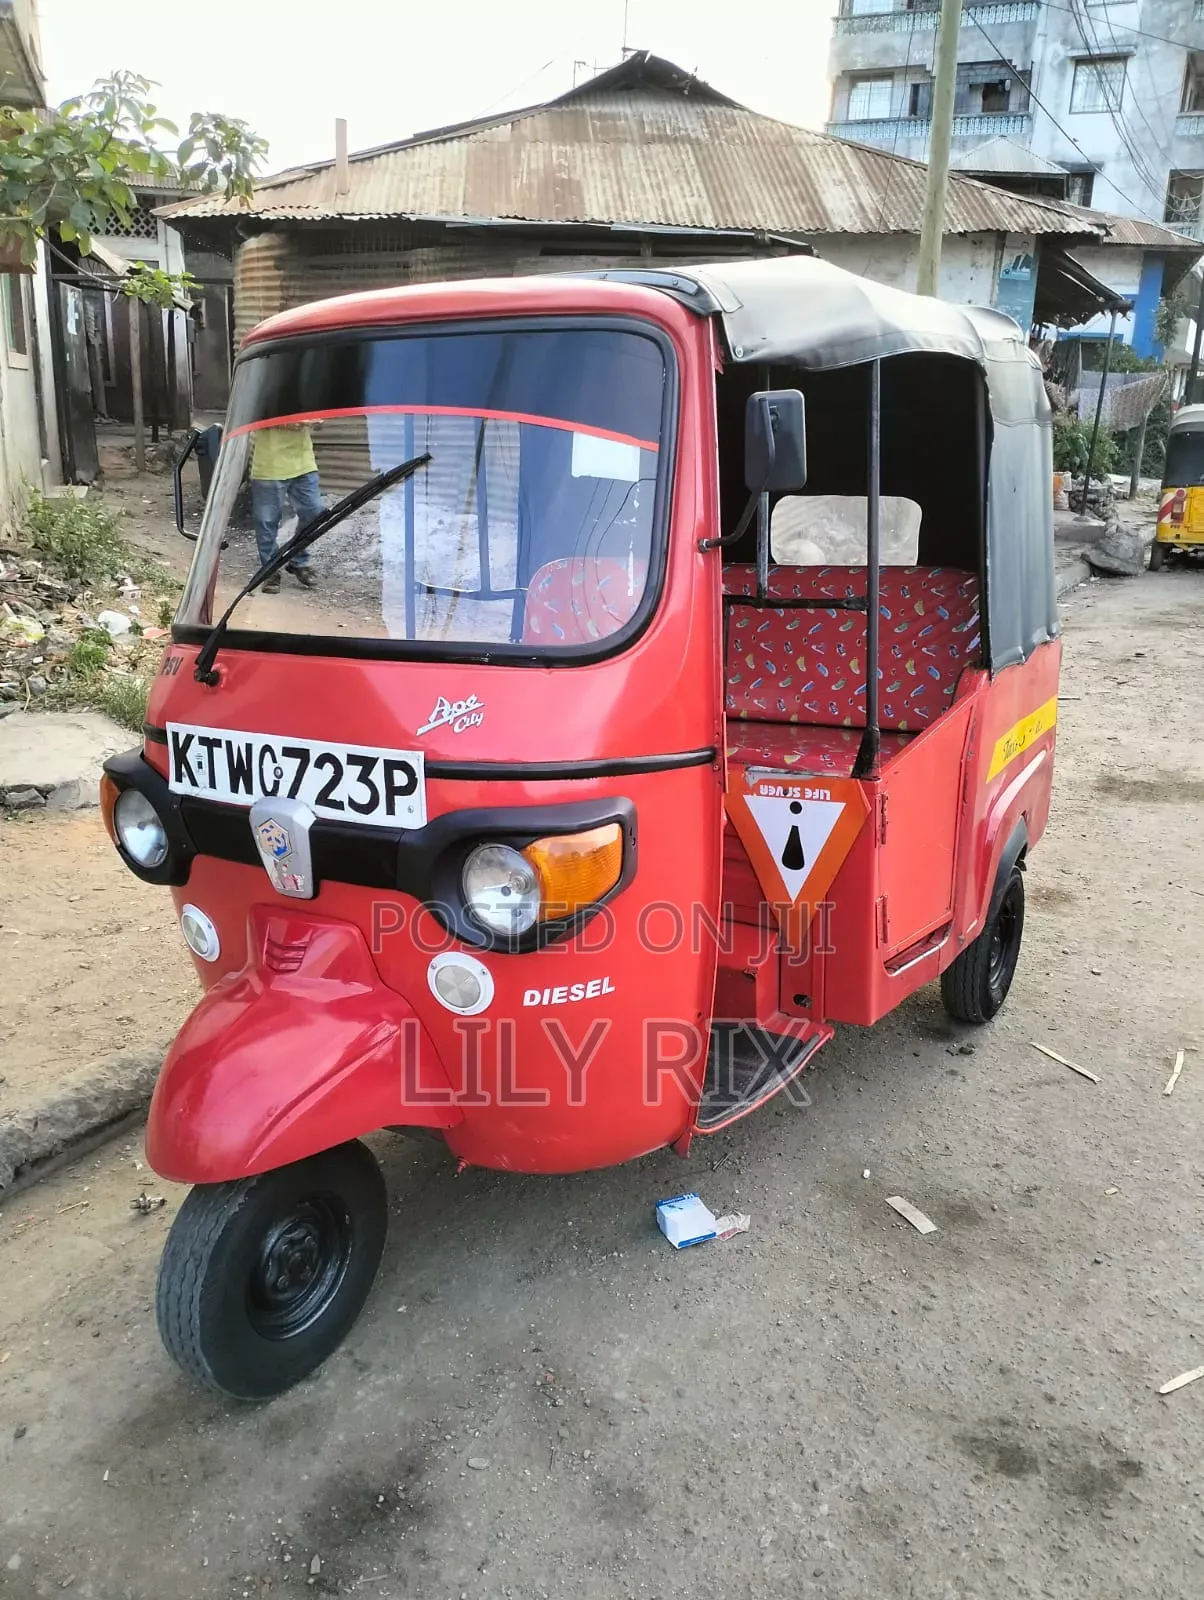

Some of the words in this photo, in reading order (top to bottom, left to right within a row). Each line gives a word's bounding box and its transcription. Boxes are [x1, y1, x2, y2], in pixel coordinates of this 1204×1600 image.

[416, 693, 485, 737] Ape
[453, 712, 484, 734] City
[804, 787, 831, 801] LIFE
[522, 976, 616, 1007] DIESEL
